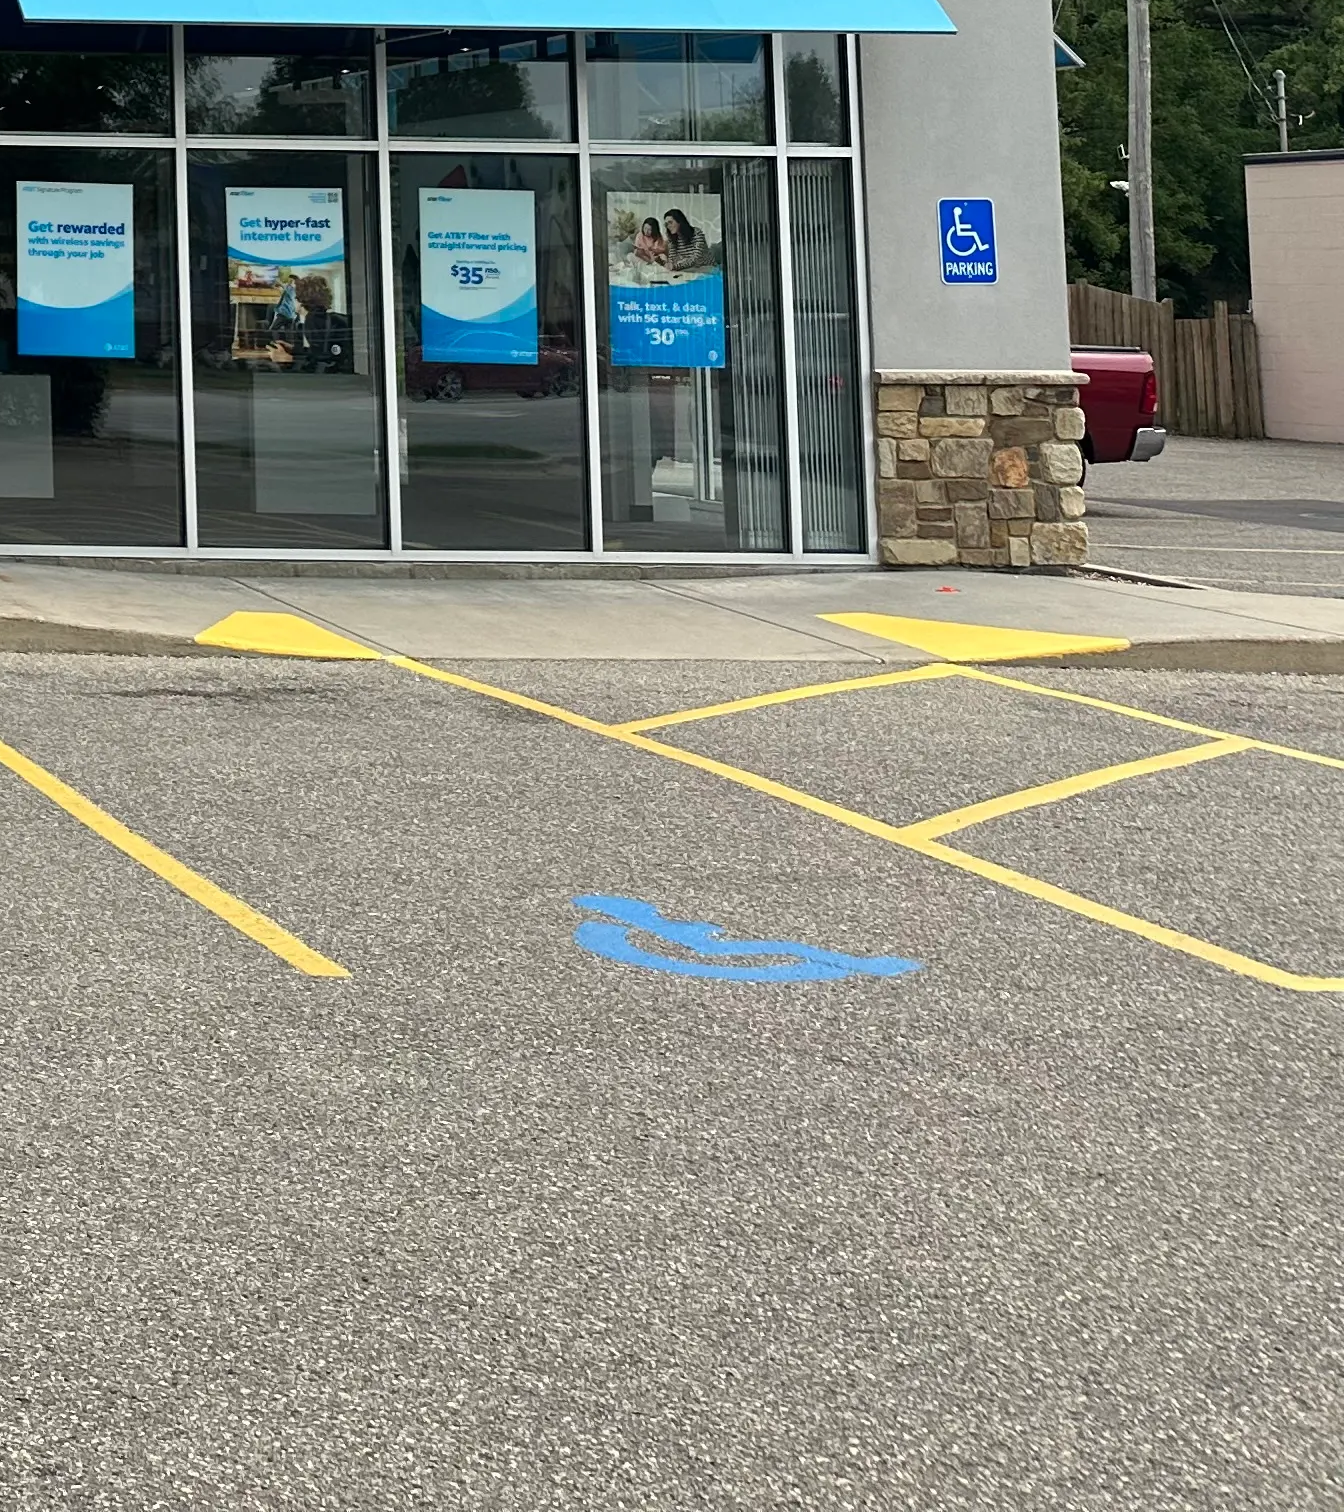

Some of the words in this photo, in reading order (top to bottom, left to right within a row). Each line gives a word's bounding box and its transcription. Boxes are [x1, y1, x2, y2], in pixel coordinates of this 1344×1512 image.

[28, 220, 54, 233] Get
[57, 222, 125, 235] rewarded
[239, 217, 262, 228] Get
[264, 217, 330, 231] hyper-fast
[28, 236, 49, 245] with
[50, 236, 89, 246] wireless
[90, 237, 125, 249] savings
[240, 230, 291, 242] internet
[293, 230, 322, 242] here
[427, 231, 443, 239] Get
[444, 231, 467, 240] AT&T
[468, 232, 490, 240] Fiber
[491, 232, 511, 241] with
[28, 248, 65, 259] through
[66, 250, 88, 260] your
[89, 250, 105, 260] job
[427, 242, 497, 251] straightforward
[497, 242, 528, 253] pricing
[450, 264, 483, 285] $35
[945, 261, 994, 276] PARKING
[617, 301, 644, 312] Talk,
[644, 302, 670, 313] text,
[672, 302, 681, 313] &
[682, 303, 707, 313] data
[618, 313, 643, 323] with
[644, 314, 659, 324] 5G
[660, 315, 704, 327] starting
[705, 316, 717, 325] at
